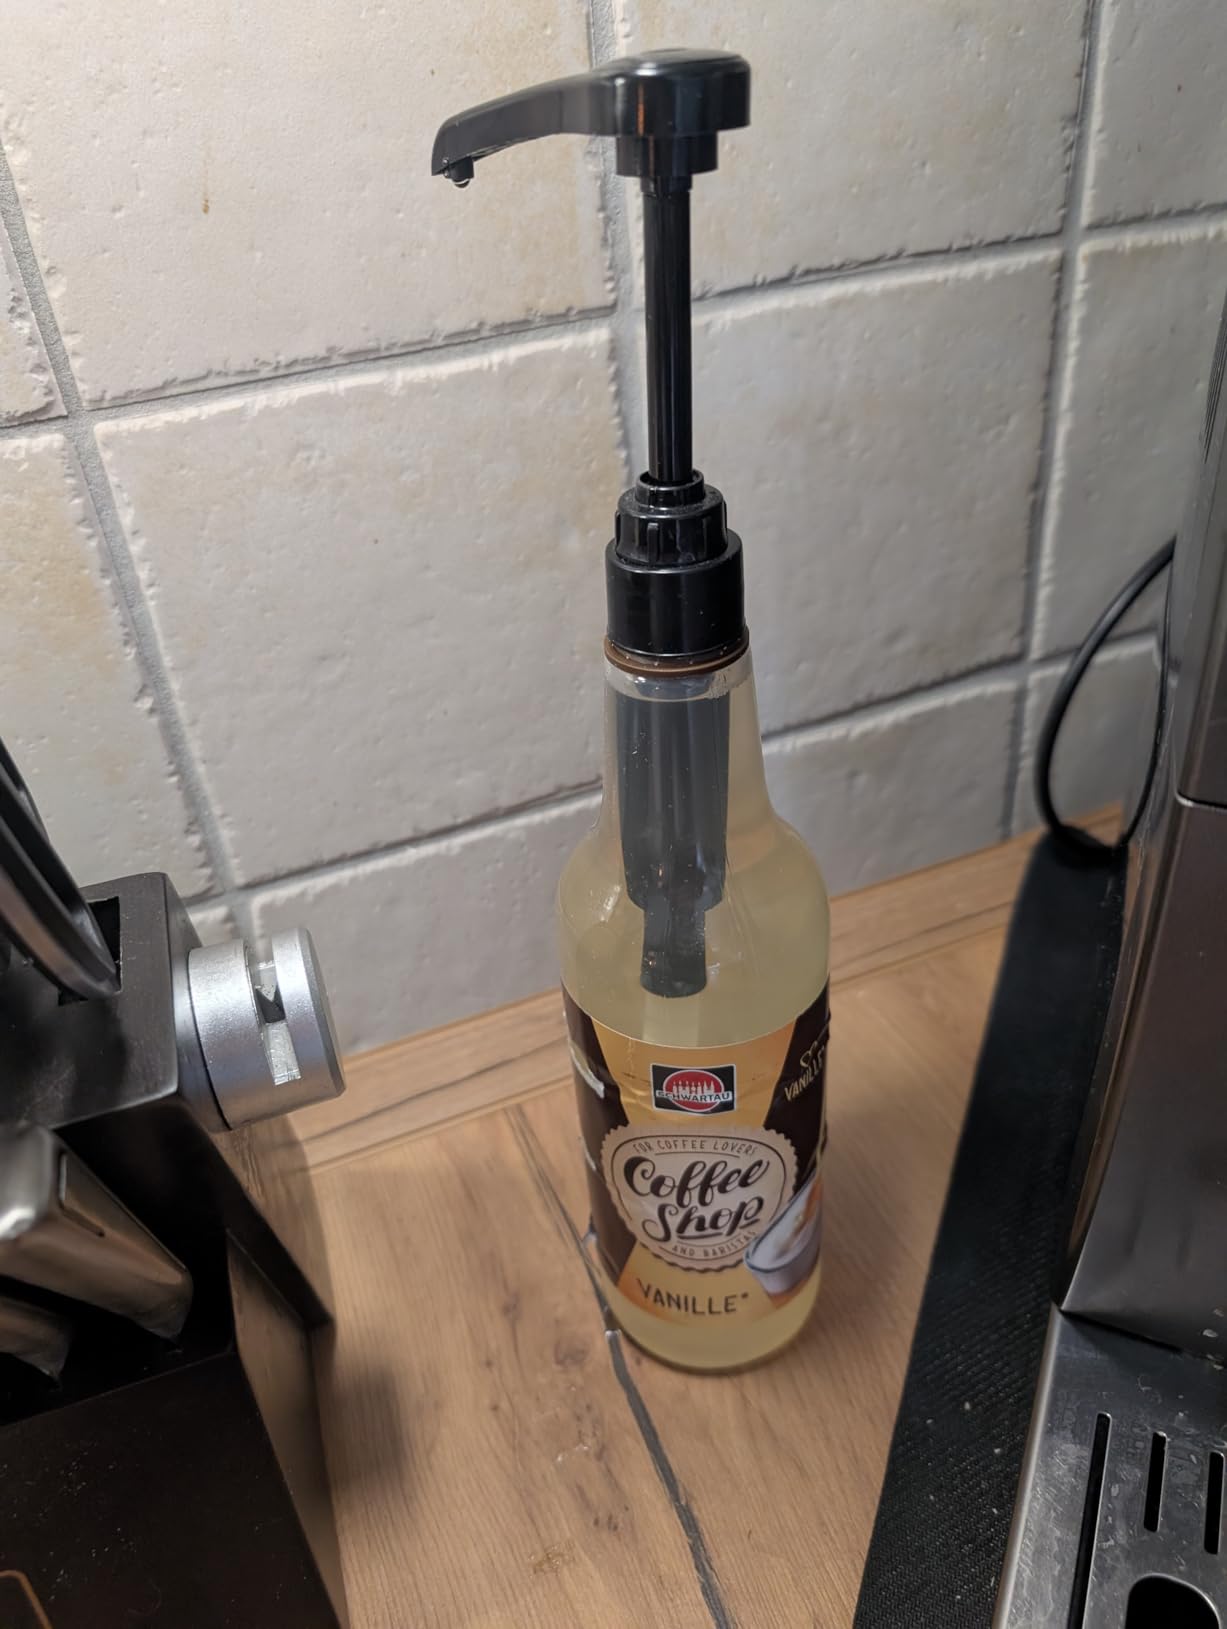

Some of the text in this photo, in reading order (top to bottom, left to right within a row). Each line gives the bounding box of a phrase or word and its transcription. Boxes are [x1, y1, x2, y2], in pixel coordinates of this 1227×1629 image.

[657, 1091, 731, 1103] SCHWARTAU
[657, 1139, 706, 1151] COFFEE
[623, 1156, 770, 1209] Coffee
[641, 1196, 764, 1242] Shop
[671, 1244, 696, 1257] AND
